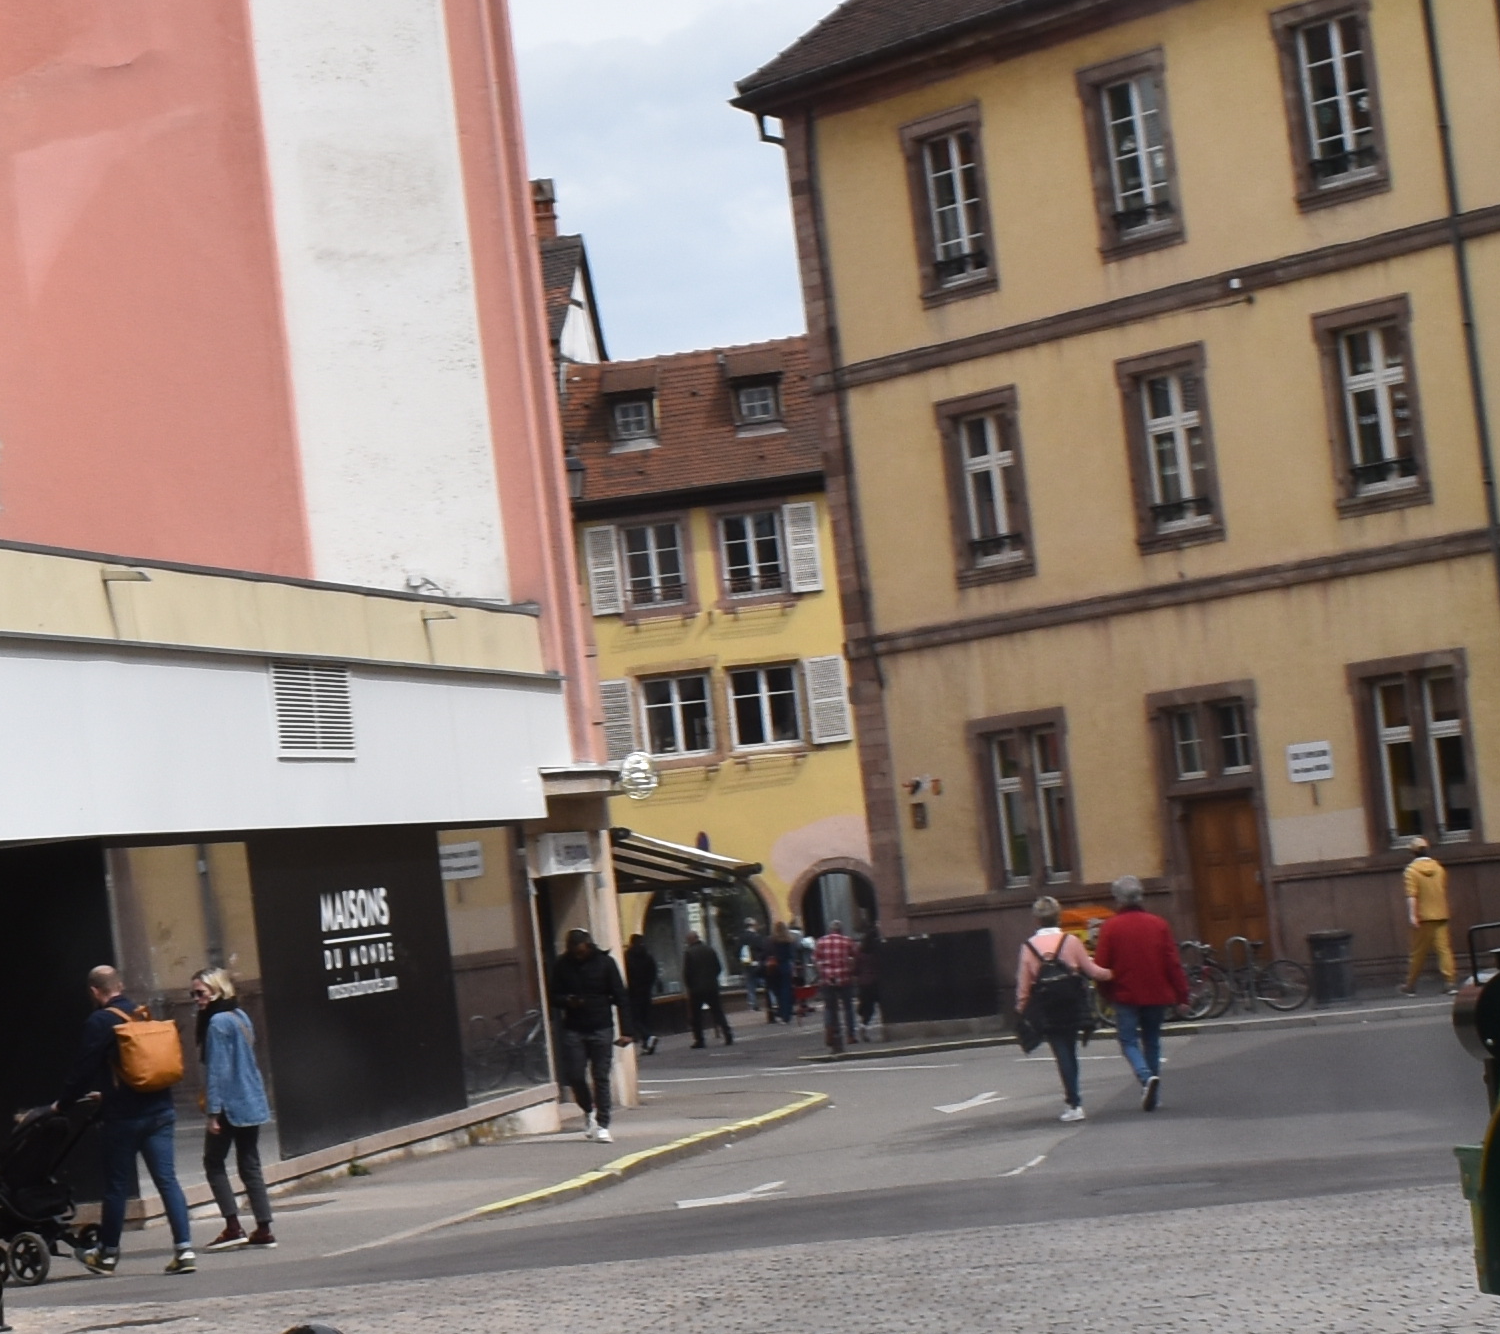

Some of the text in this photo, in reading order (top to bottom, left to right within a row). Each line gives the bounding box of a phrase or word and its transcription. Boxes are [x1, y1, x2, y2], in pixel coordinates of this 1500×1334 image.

[319, 887, 391, 933] MAISONS
[323, 941, 396, 971] DU MONDE
